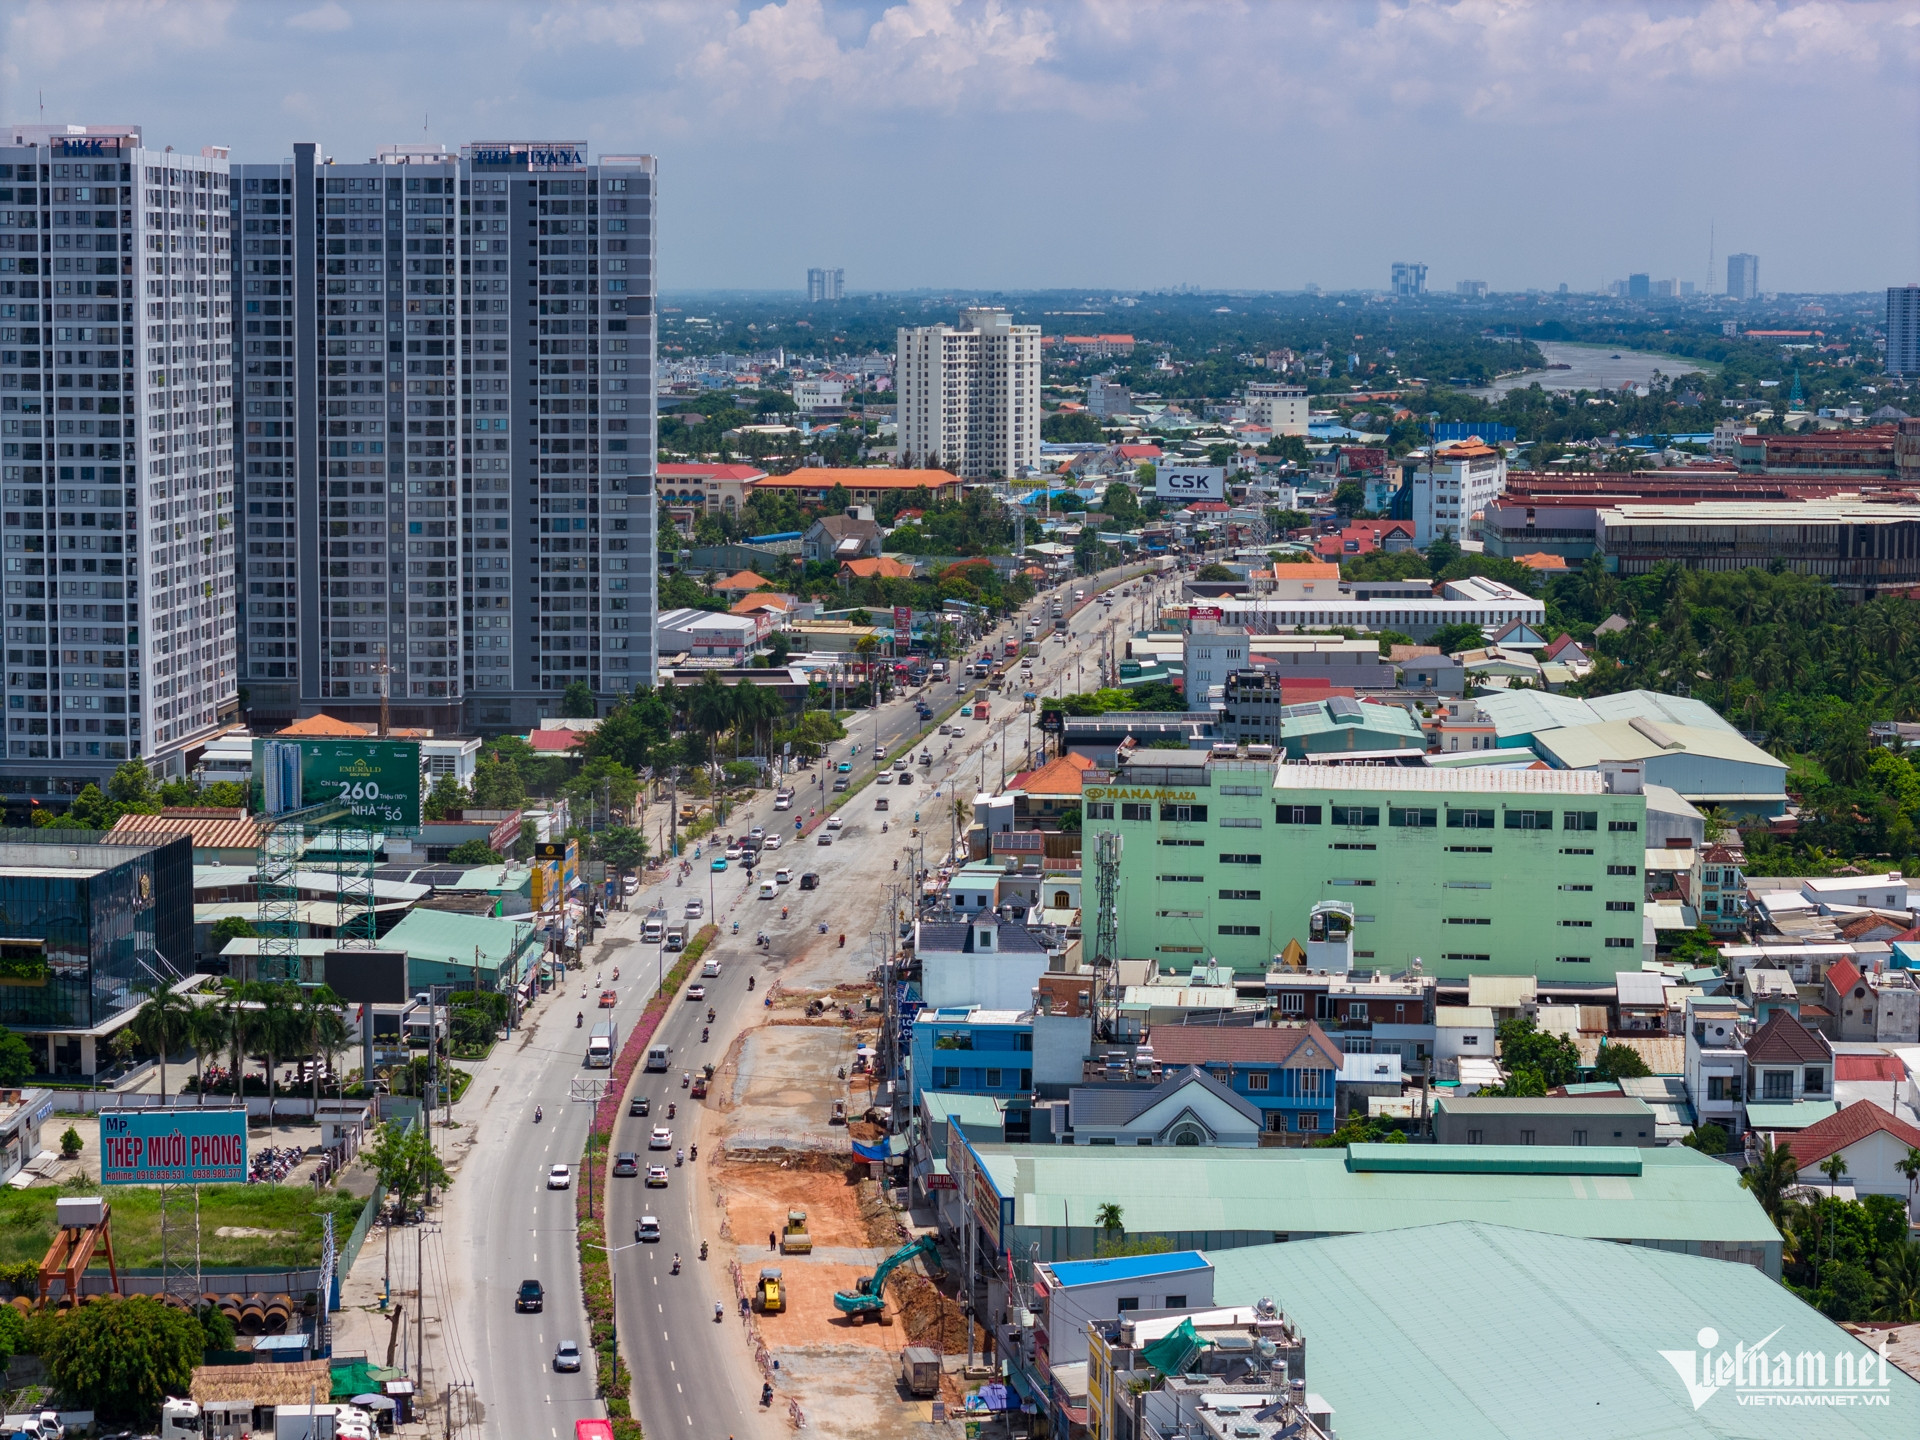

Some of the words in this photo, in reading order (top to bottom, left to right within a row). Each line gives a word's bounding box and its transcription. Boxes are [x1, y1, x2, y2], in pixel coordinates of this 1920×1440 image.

[64, 139, 104, 156] HKK
[475, 151, 511, 164] THE
[1169, 475, 1209, 488] CSK
[339, 781, 379, 800] 260
[1107, 788, 1167, 800] HANAM
[1167, 791, 1196, 800] PLAZA
[351, 803, 377, 816] NHÀ
[105, 1131, 144, 1168] THÉP
[147, 1129, 186, 1167] MƯỜI
[191, 1134, 242, 1166] PHONG
[106, 1171, 134, 1181] Hotline:
[136, 1170, 185, 1180] 0916.836.531
[192, 1169, 242, 1179] 0938.980.377
